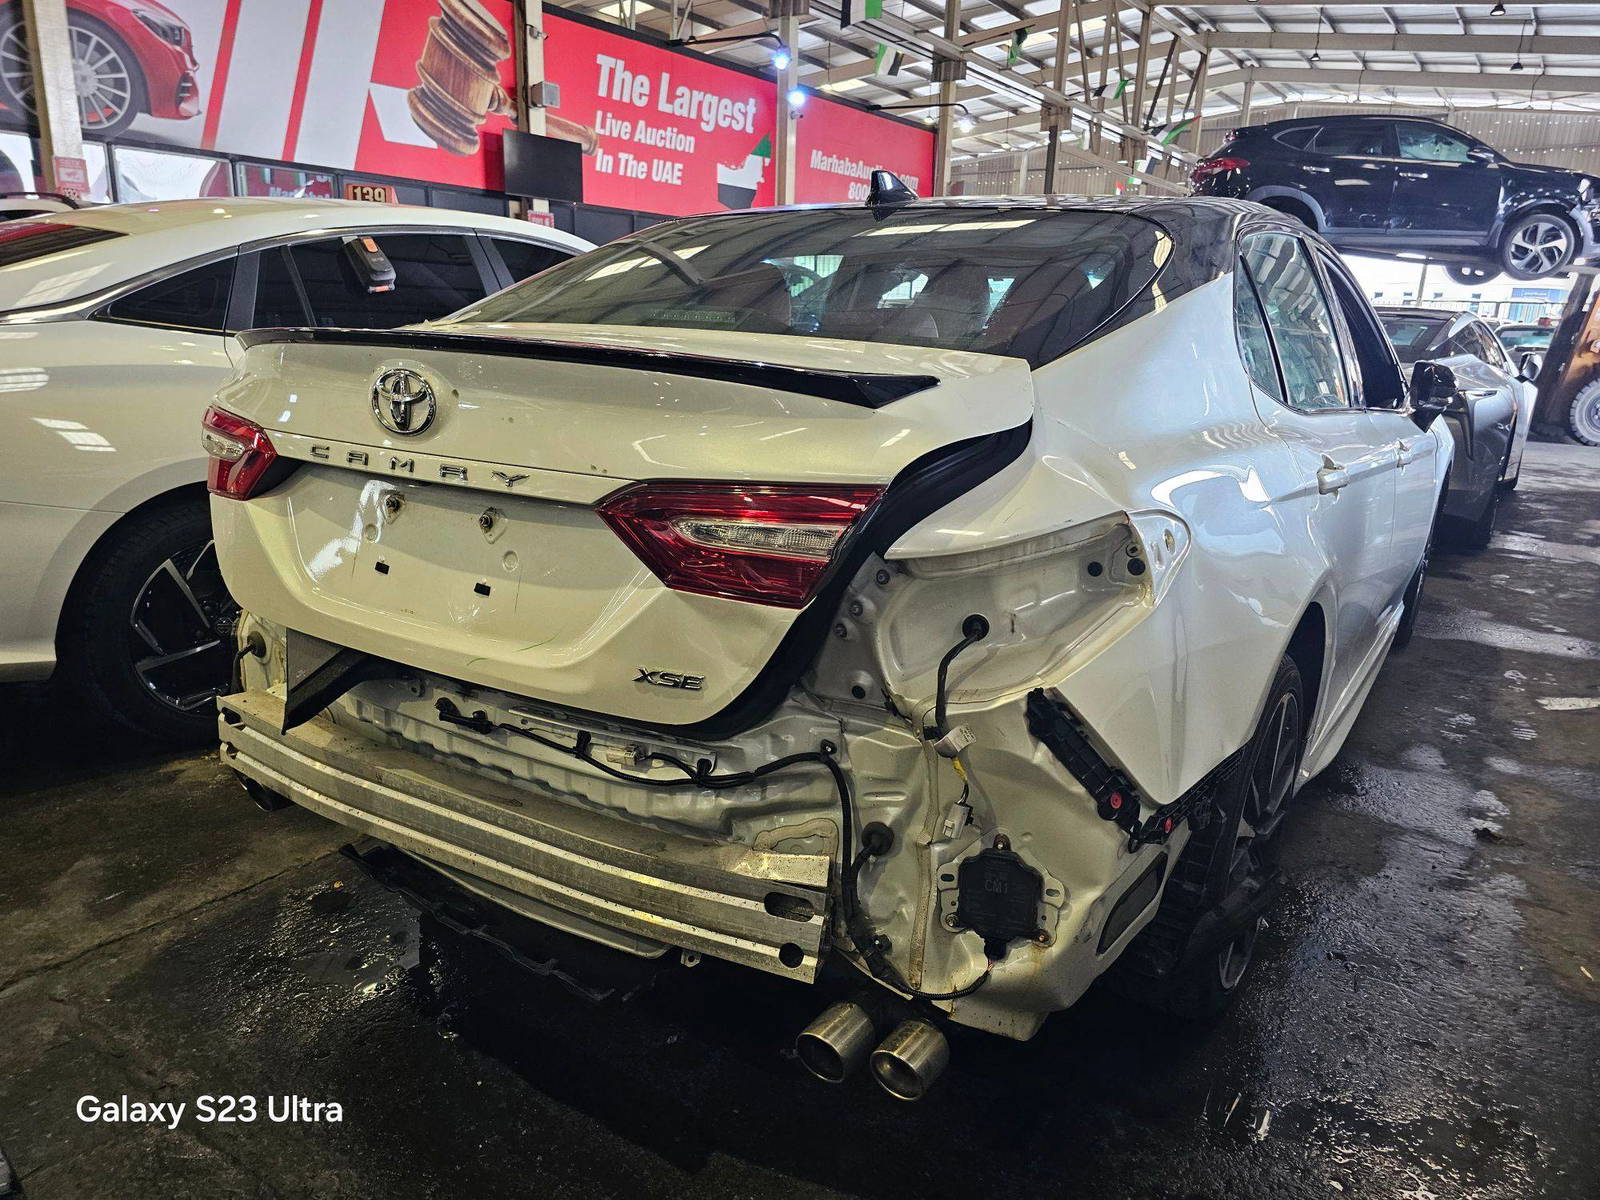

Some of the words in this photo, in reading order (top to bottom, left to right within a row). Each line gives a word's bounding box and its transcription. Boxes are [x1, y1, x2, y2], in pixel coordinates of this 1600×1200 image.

[596, 54, 650, 107] The
[658, 72, 757, 134] Largest
[595, 110, 632, 140] Live
[633, 120, 696, 153] Auction
[595, 148, 614, 174] In
[618, 152, 648, 179] The
[652, 158, 684, 185] UAE
[353, 186, 387, 203] 139
[311, 446, 530, 487] CAMRY
[632, 667, 706, 691] XSE
